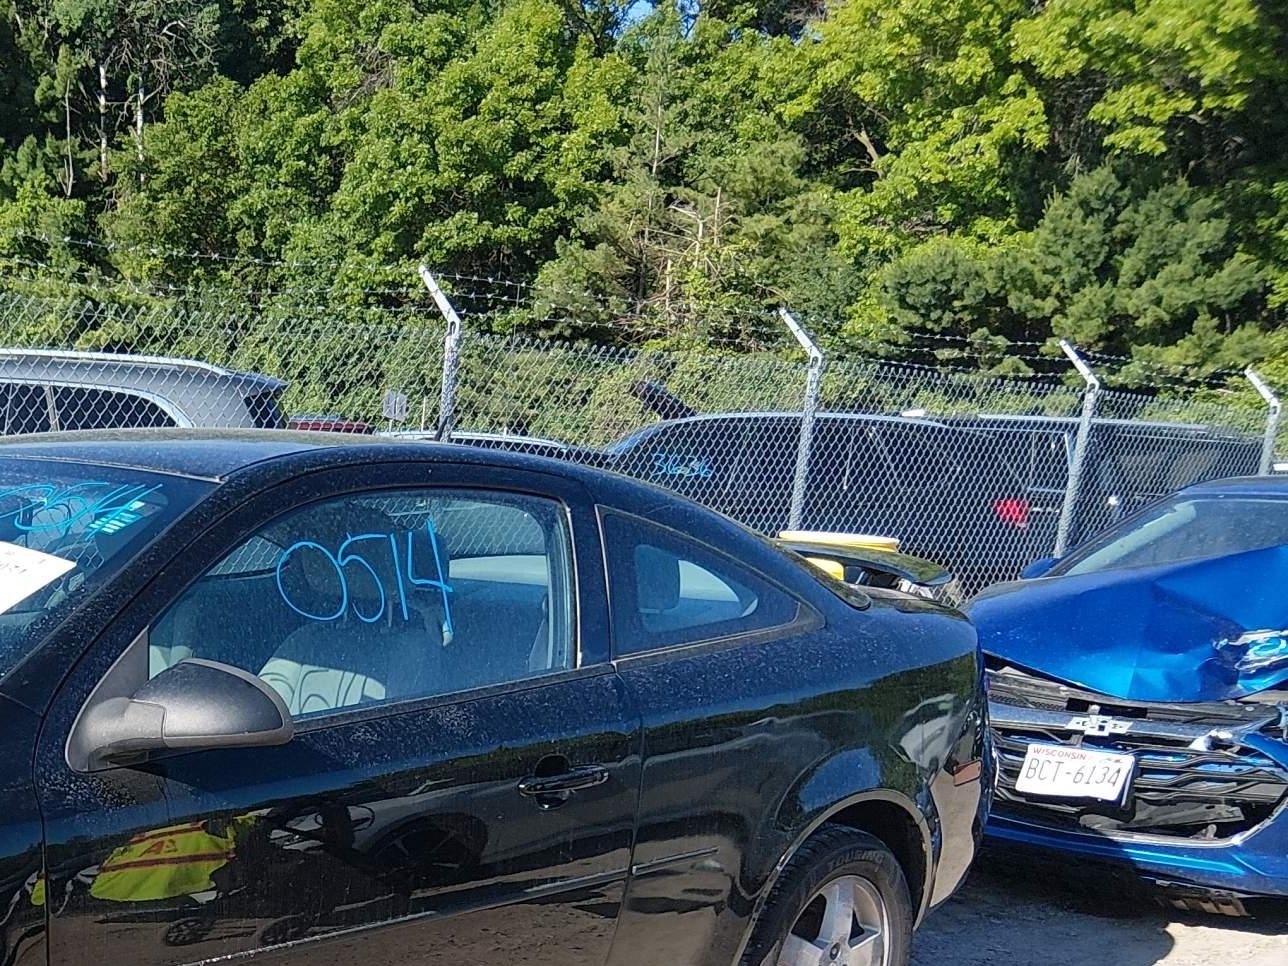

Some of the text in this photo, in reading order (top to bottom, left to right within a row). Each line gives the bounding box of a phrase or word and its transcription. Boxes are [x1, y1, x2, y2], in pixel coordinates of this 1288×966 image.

[275, 515, 454, 636] 0514
[1032, 746, 1087, 760] WISCONSIN
[1024, 757, 1122, 787] BCT-6134
